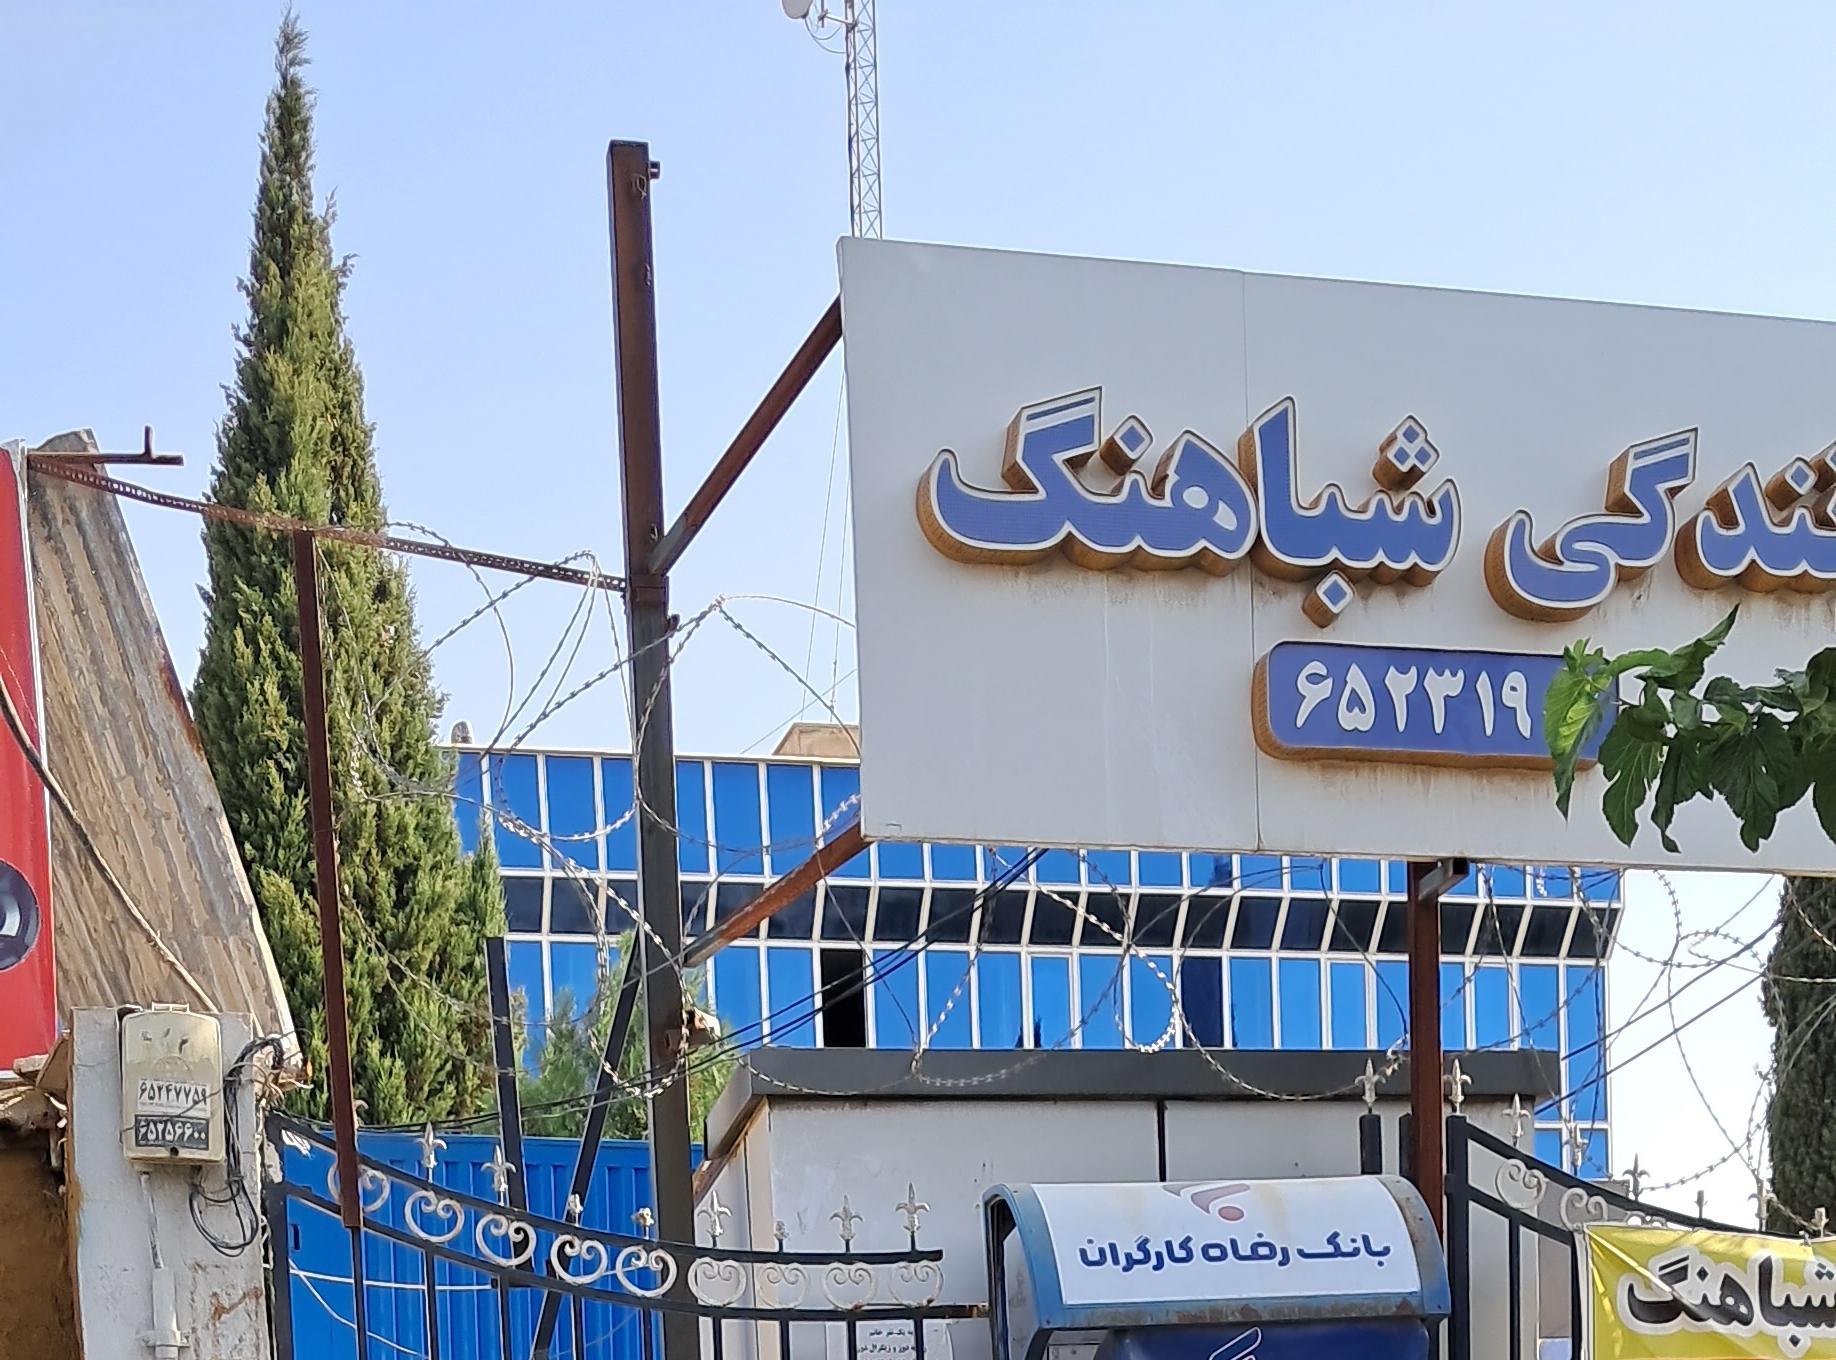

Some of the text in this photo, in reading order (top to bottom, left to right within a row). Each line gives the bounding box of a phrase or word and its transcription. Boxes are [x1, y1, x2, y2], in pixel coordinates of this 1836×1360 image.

[926, 386, 1836, 622] ندگی شباهنگ
[1295, 660, 1532, 739] ۶۵۲۳۱۹
[1078, 1230, 1391, 1273] بانک رفاه کارگران
[1628, 1255, 1836, 1347] شباهنگ
